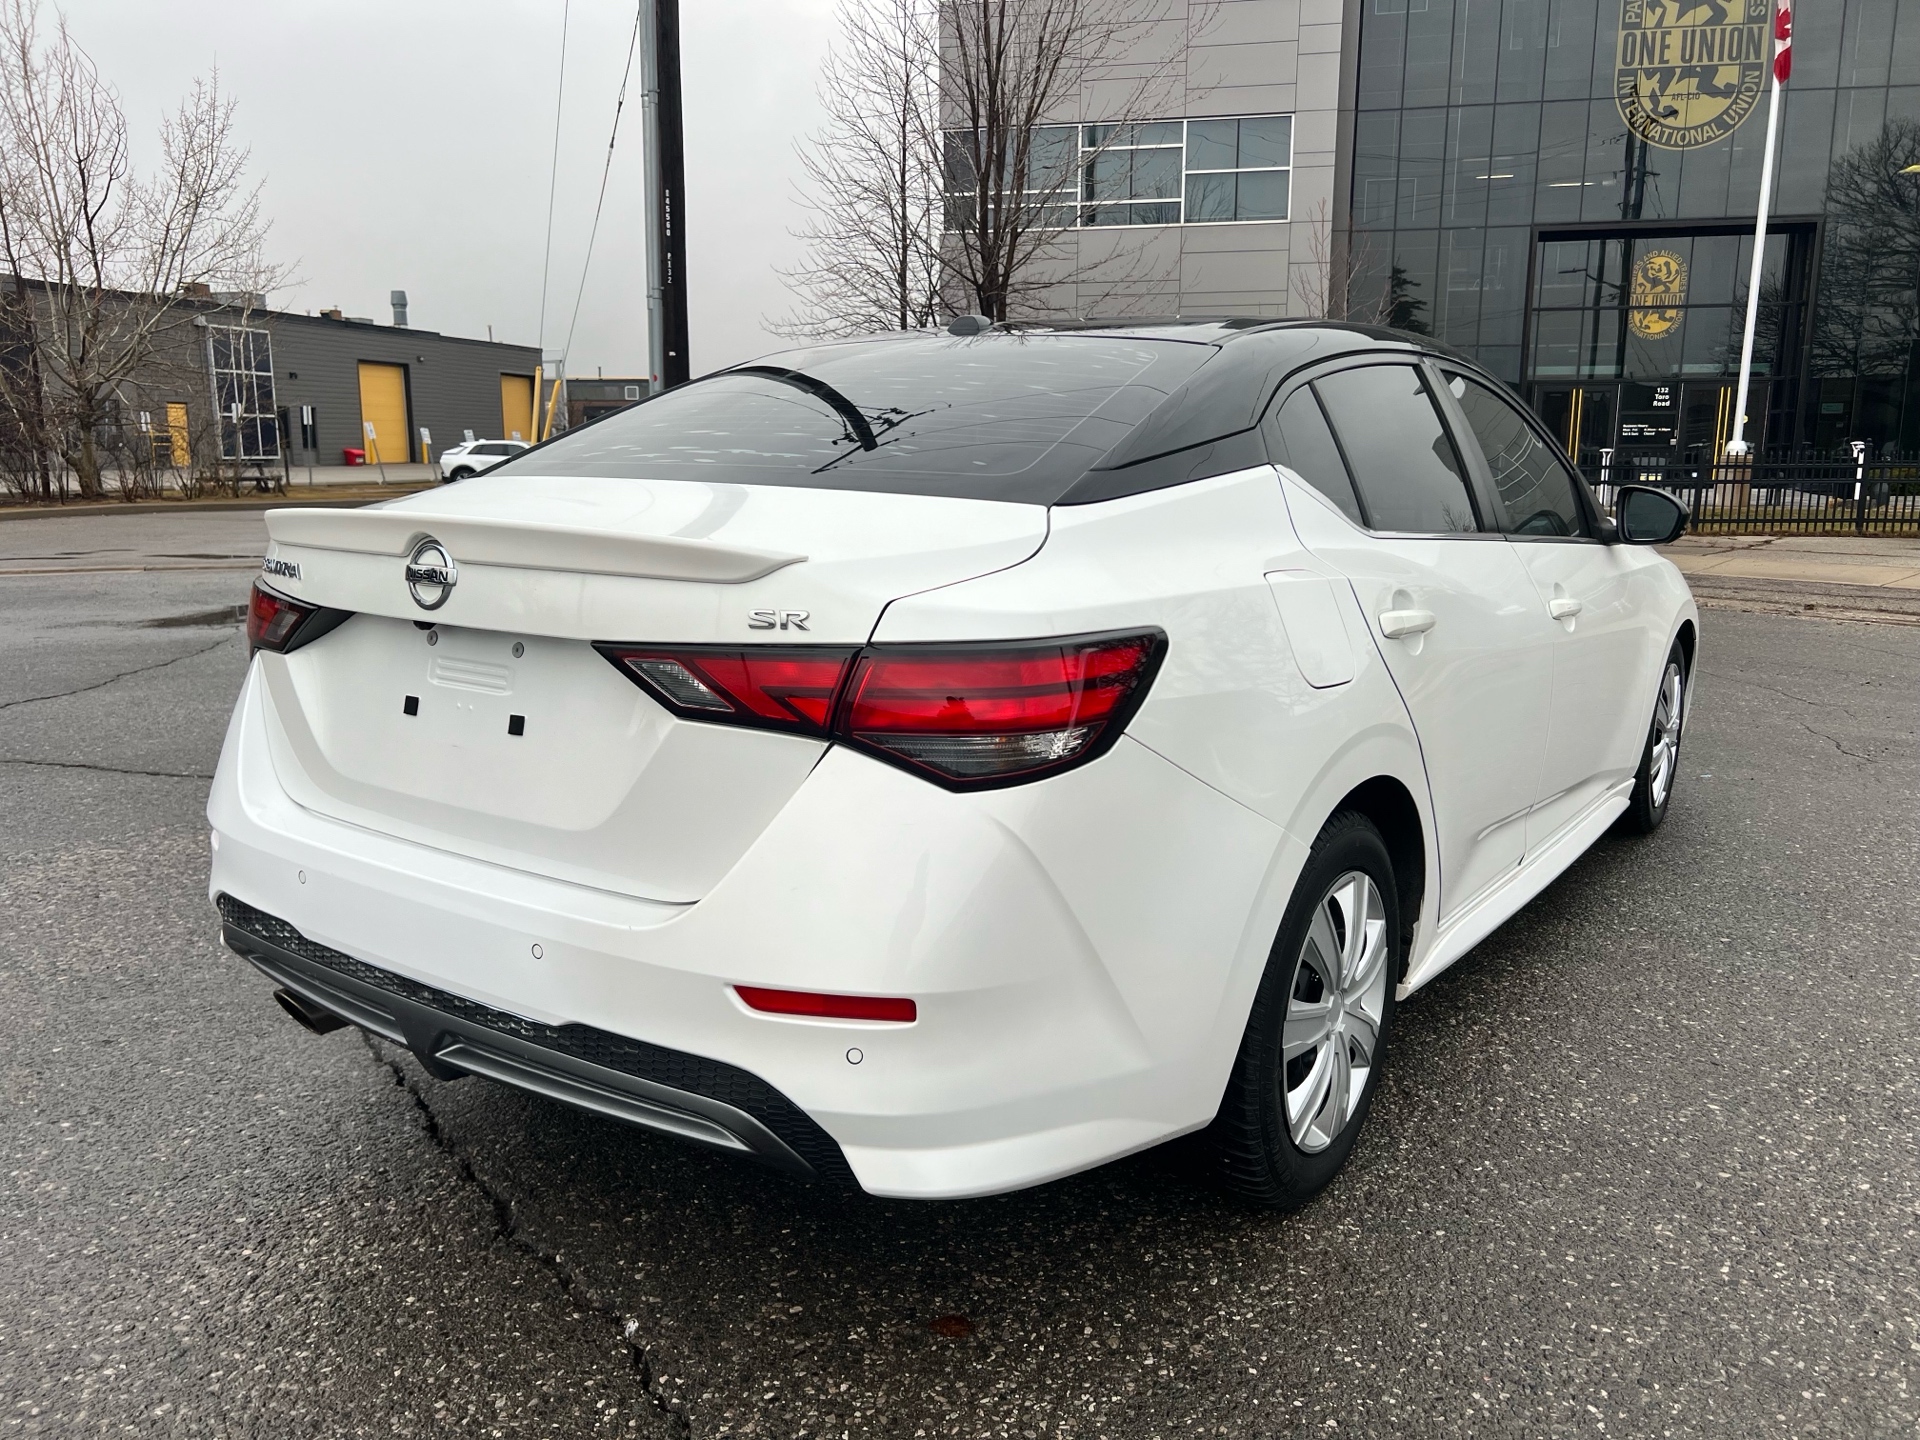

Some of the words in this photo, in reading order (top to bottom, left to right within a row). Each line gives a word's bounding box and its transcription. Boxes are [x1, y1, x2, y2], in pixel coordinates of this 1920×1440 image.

[1622, 30, 1671, 67] ONE
[1681, 26, 1764, 64] UNION
[1619, 76, 1724, 146] INTERNATIONAL
[1722, 71, 1760, 125] UNION
[1671, 92, 1700, 101] AFL-CIO
[1644, 250, 1658, 262] AND
[1660, 250, 1682, 264] ALLIED
[1680, 262, 1688, 290] TRADES
[1630, 293, 1649, 306] ONE
[1652, 292, 1685, 306] UNION
[1628, 311, 1668, 340] INTERNATIONAL
[1668, 311, 1684, 333] UNION
[408, 567, 449, 582] NISSAN
[748, 608, 810, 631] SR
